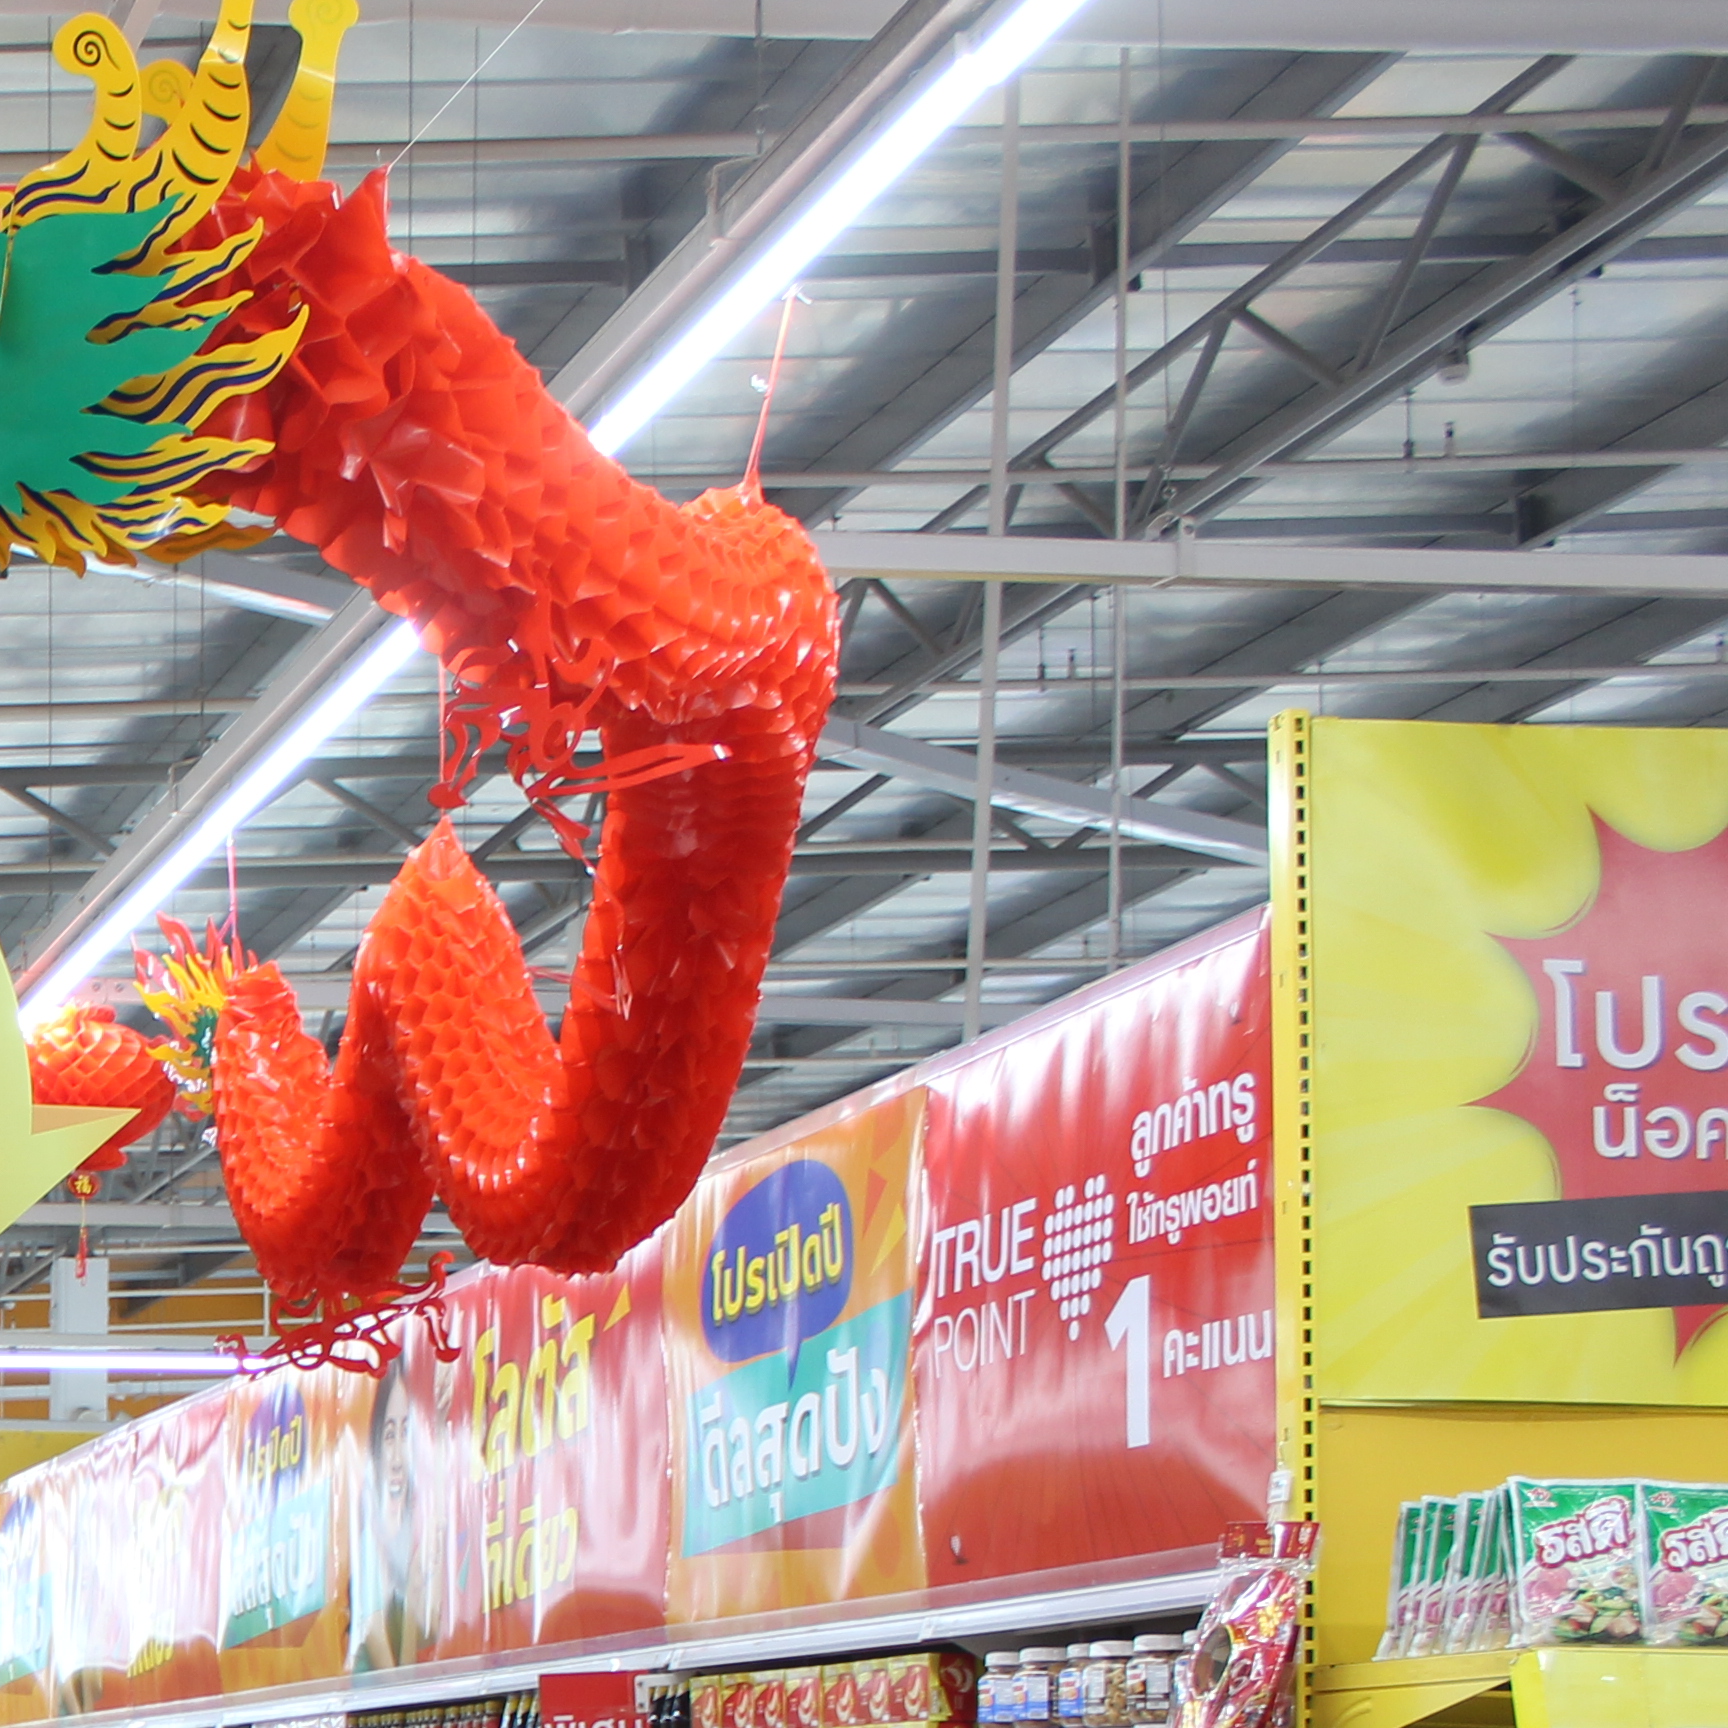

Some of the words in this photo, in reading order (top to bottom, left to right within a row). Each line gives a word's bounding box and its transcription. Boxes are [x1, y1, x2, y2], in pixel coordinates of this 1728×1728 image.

[1129, 1070, 1256, 1179] ลูกค้าทรู
[935, 1196, 1038, 1299] TRUE
[1126, 1160, 1258, 1249] ใช้ทรูพอยท์
[709, 1203, 843, 1326] โปรเปิดปี
[934, 1288, 1038, 1380] POINT
[1104, 1275, 1152, 1449] 1
[1162, 1308, 1273, 1379] คะแนน
[471, 1295, 595, 1480] โลตัส
[701, 1345, 889, 1524] ดีลสุดปัง
[1535, 1494, 1631, 1566] รสดี
